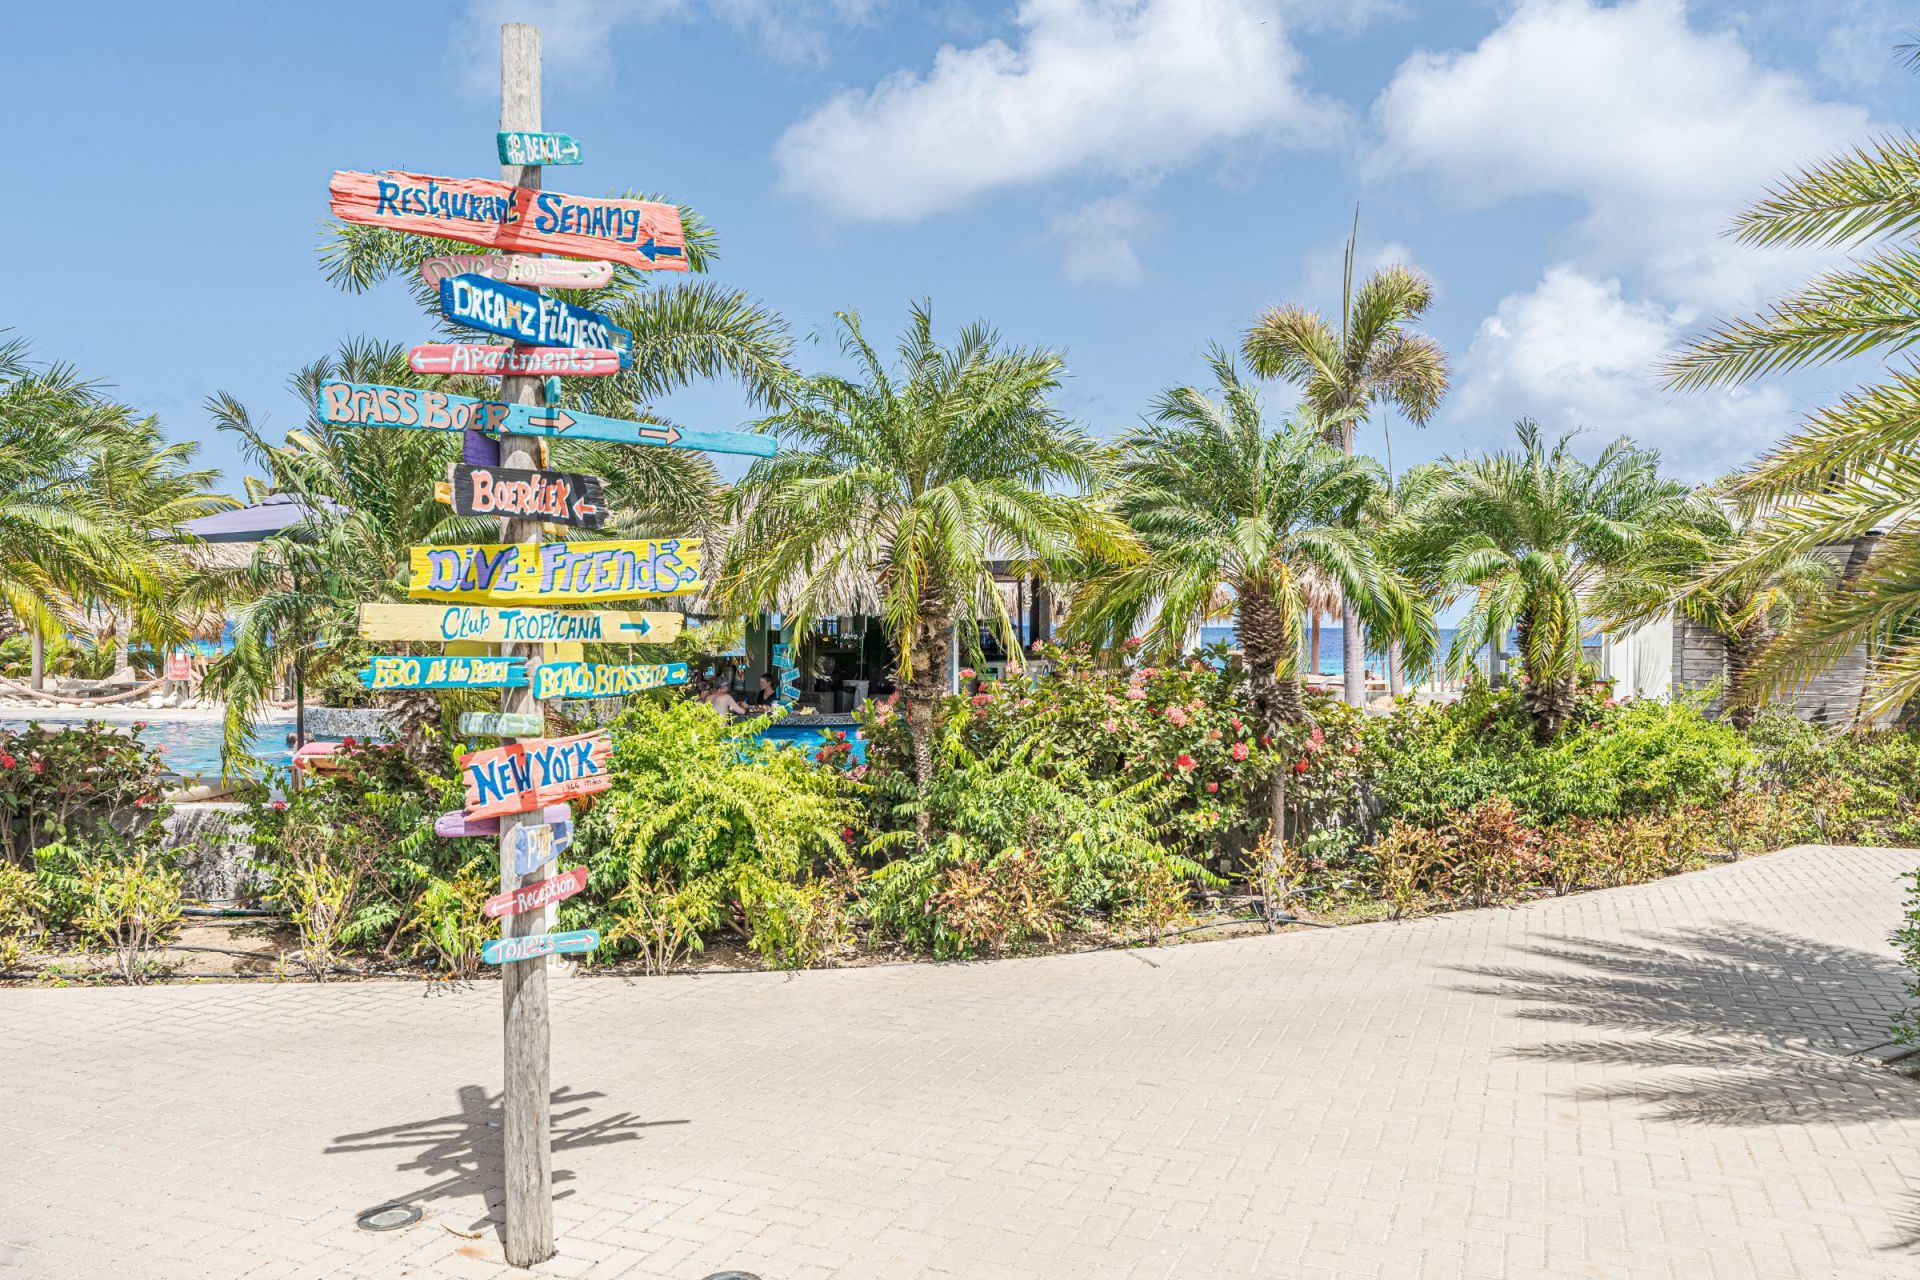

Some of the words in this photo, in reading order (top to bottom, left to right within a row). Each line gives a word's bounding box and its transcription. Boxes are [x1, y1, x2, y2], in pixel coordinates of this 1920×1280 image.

[441, 606, 491, 641] Club
[372, 658, 421, 689] BBQ
[468, 751, 534, 808] NEW
[516, 875, 576, 914] Reception
